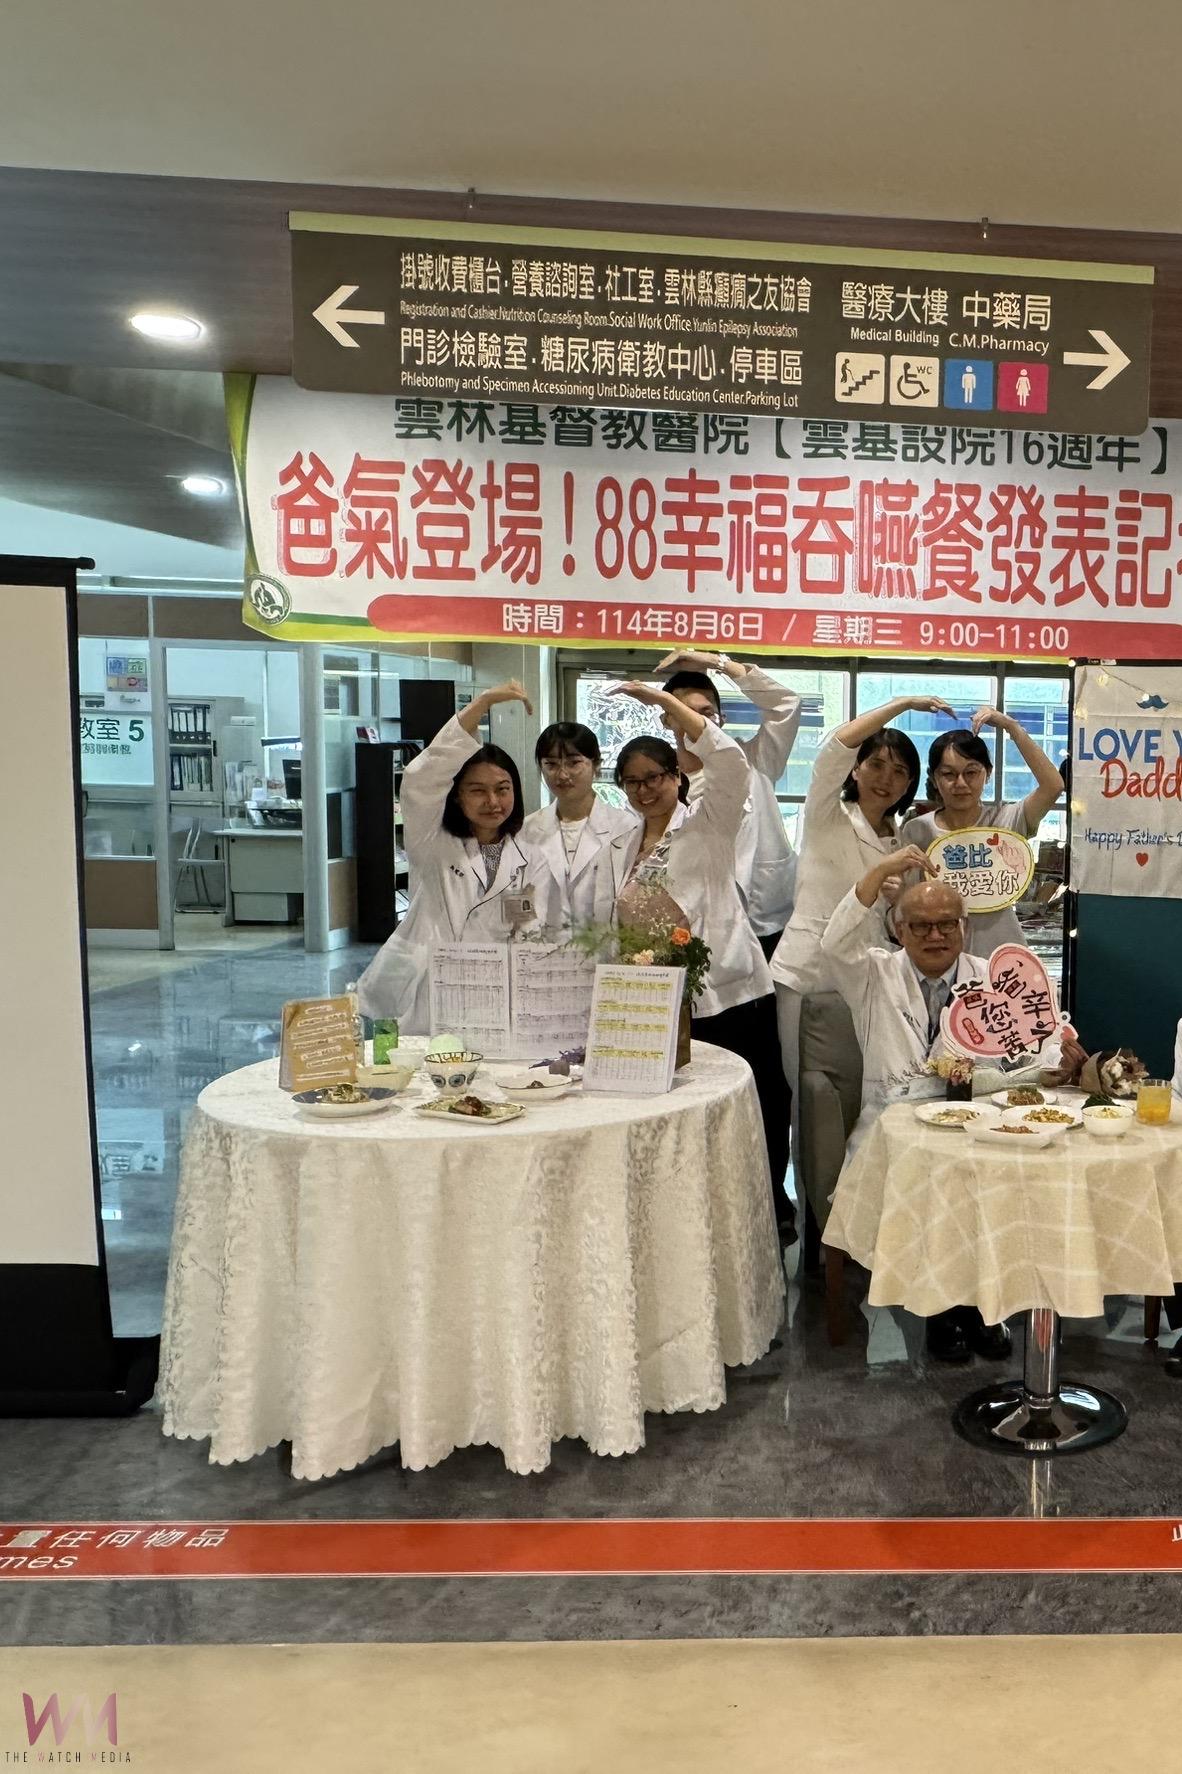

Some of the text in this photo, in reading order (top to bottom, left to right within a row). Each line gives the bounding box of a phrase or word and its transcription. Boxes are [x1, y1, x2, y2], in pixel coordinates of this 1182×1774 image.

[400, 300, 449, 319] Registration
[451, 304, 466, 319] and
[537, 308, 582, 329] Counseling
[638, 313, 662, 330] Work
[719, 319, 751, 339] Epilepsy
[753, 321, 798, 338] Association
[841, 281, 1052, 332] 醫療大樓 中藥局
[850, 326, 1050, 356] Medical Building C.M.Pharmacy
[916, 366, 933, 376] WC
[400, 371, 459, 393] Phlebotomy
[462, 376, 480, 390] and
[483, 377, 530, 395] Specimen
[532, 379, 595, 400] Accessioning
[663, 386, 711, 402] Education
[783, 393, 798, 407] Lot
[812, 614, 903, 646] 星期三
[919, 619, 1069, 651] 9:00-11:00
[128, 719, 145, 742] 5
[1078, 727, 1164, 764] LOVE
[1085, 828, 1122, 851] Happy
[1126, 828, 1174, 846] Father's
[942, 843, 993, 870] 爸比
[943, 870, 1020, 896] 我愛你
